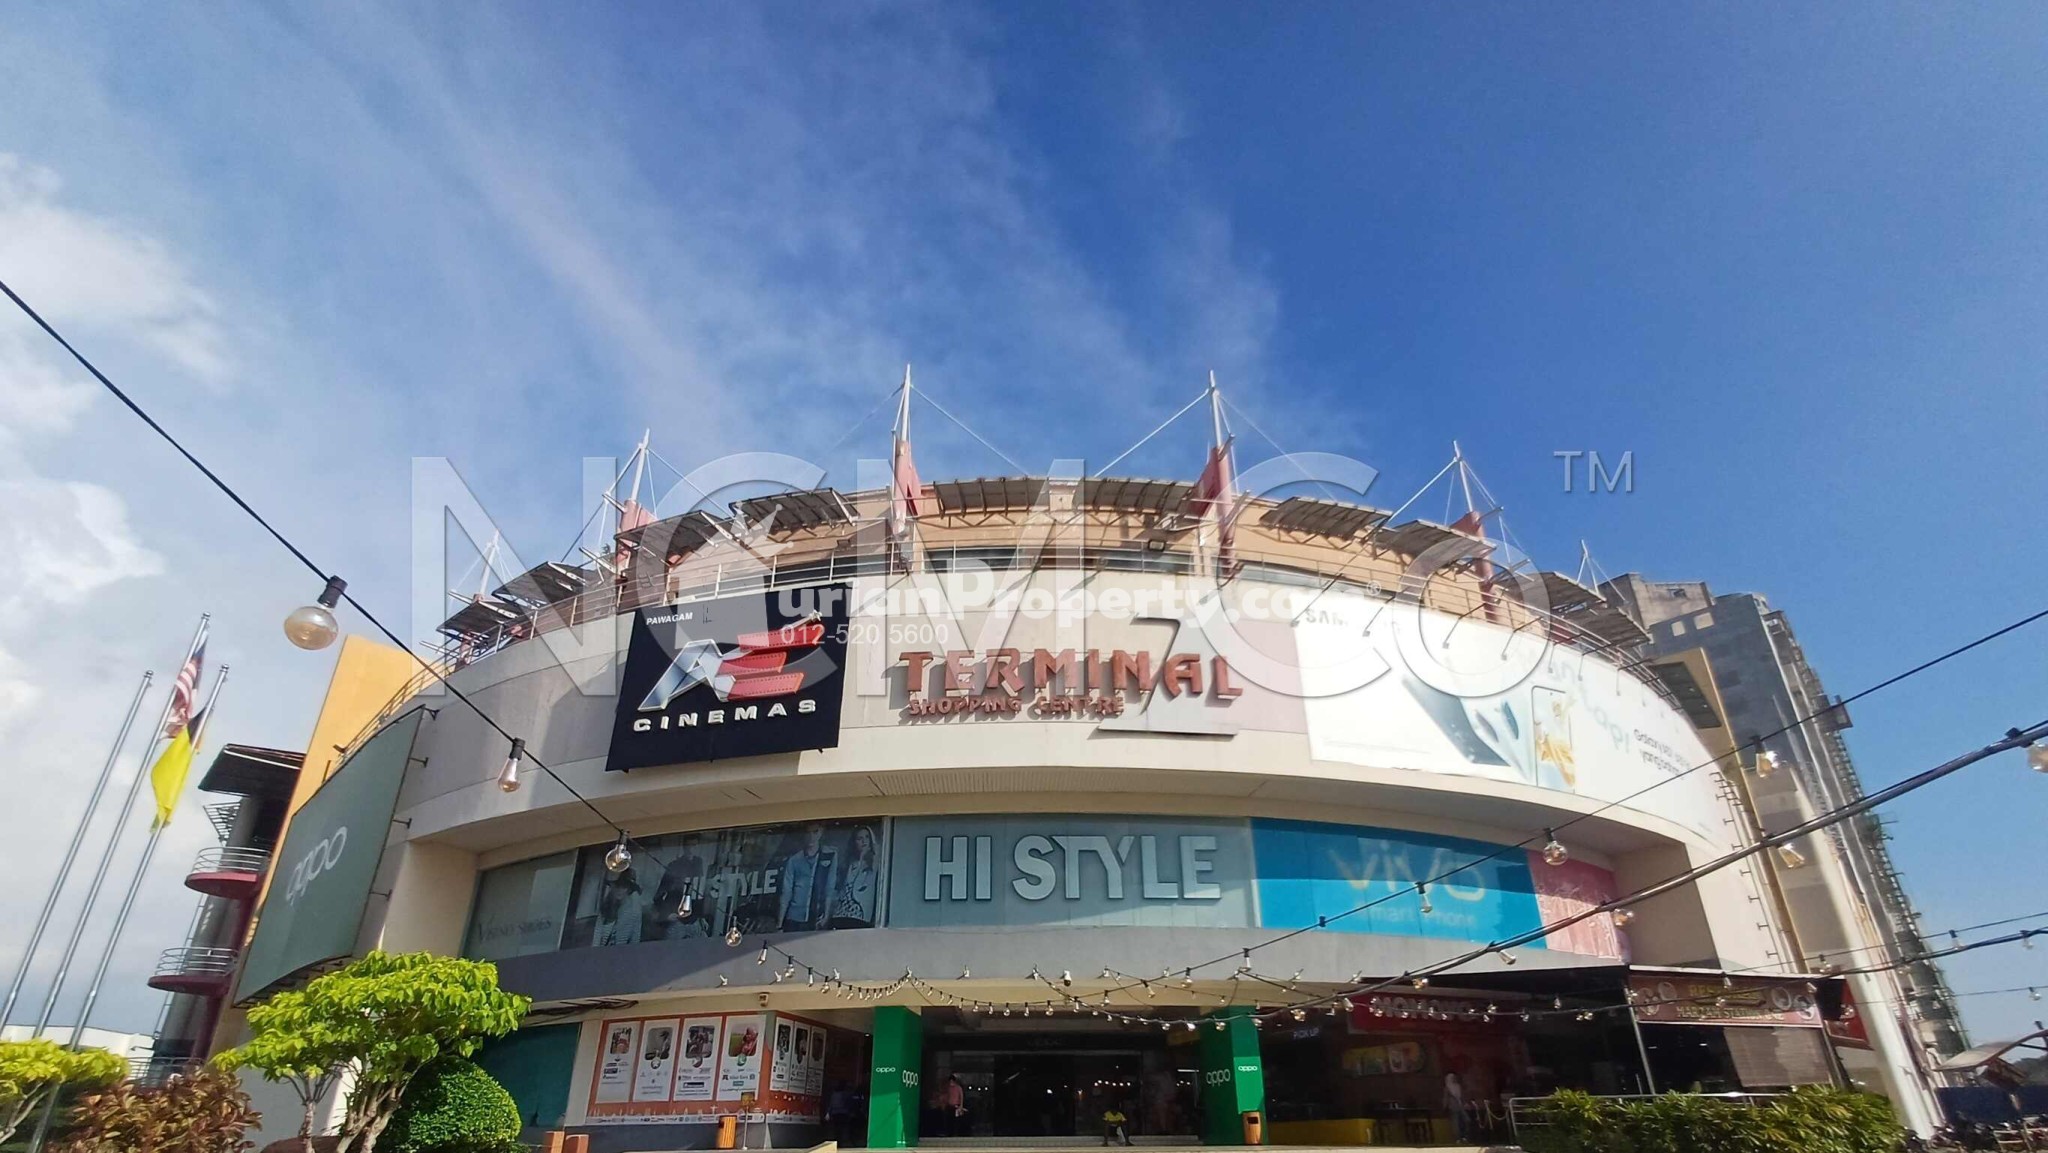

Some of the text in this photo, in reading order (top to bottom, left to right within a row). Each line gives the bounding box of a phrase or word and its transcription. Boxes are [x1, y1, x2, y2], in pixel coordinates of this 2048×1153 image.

[646, 611, 694, 626] PAWAGAM
[900, 647, 1244, 701] TERMINAL
[633, 699, 816, 732] CINEMAS
[909, 696, 1125, 716] SHOPPING CENTRE
[925, 834, 1222, 902] HI STYLE
[709, 868, 778, 900] STYLE
[902, 1069, 918, 1088] oppo
[1206, 1068, 1231, 1087] oppo
